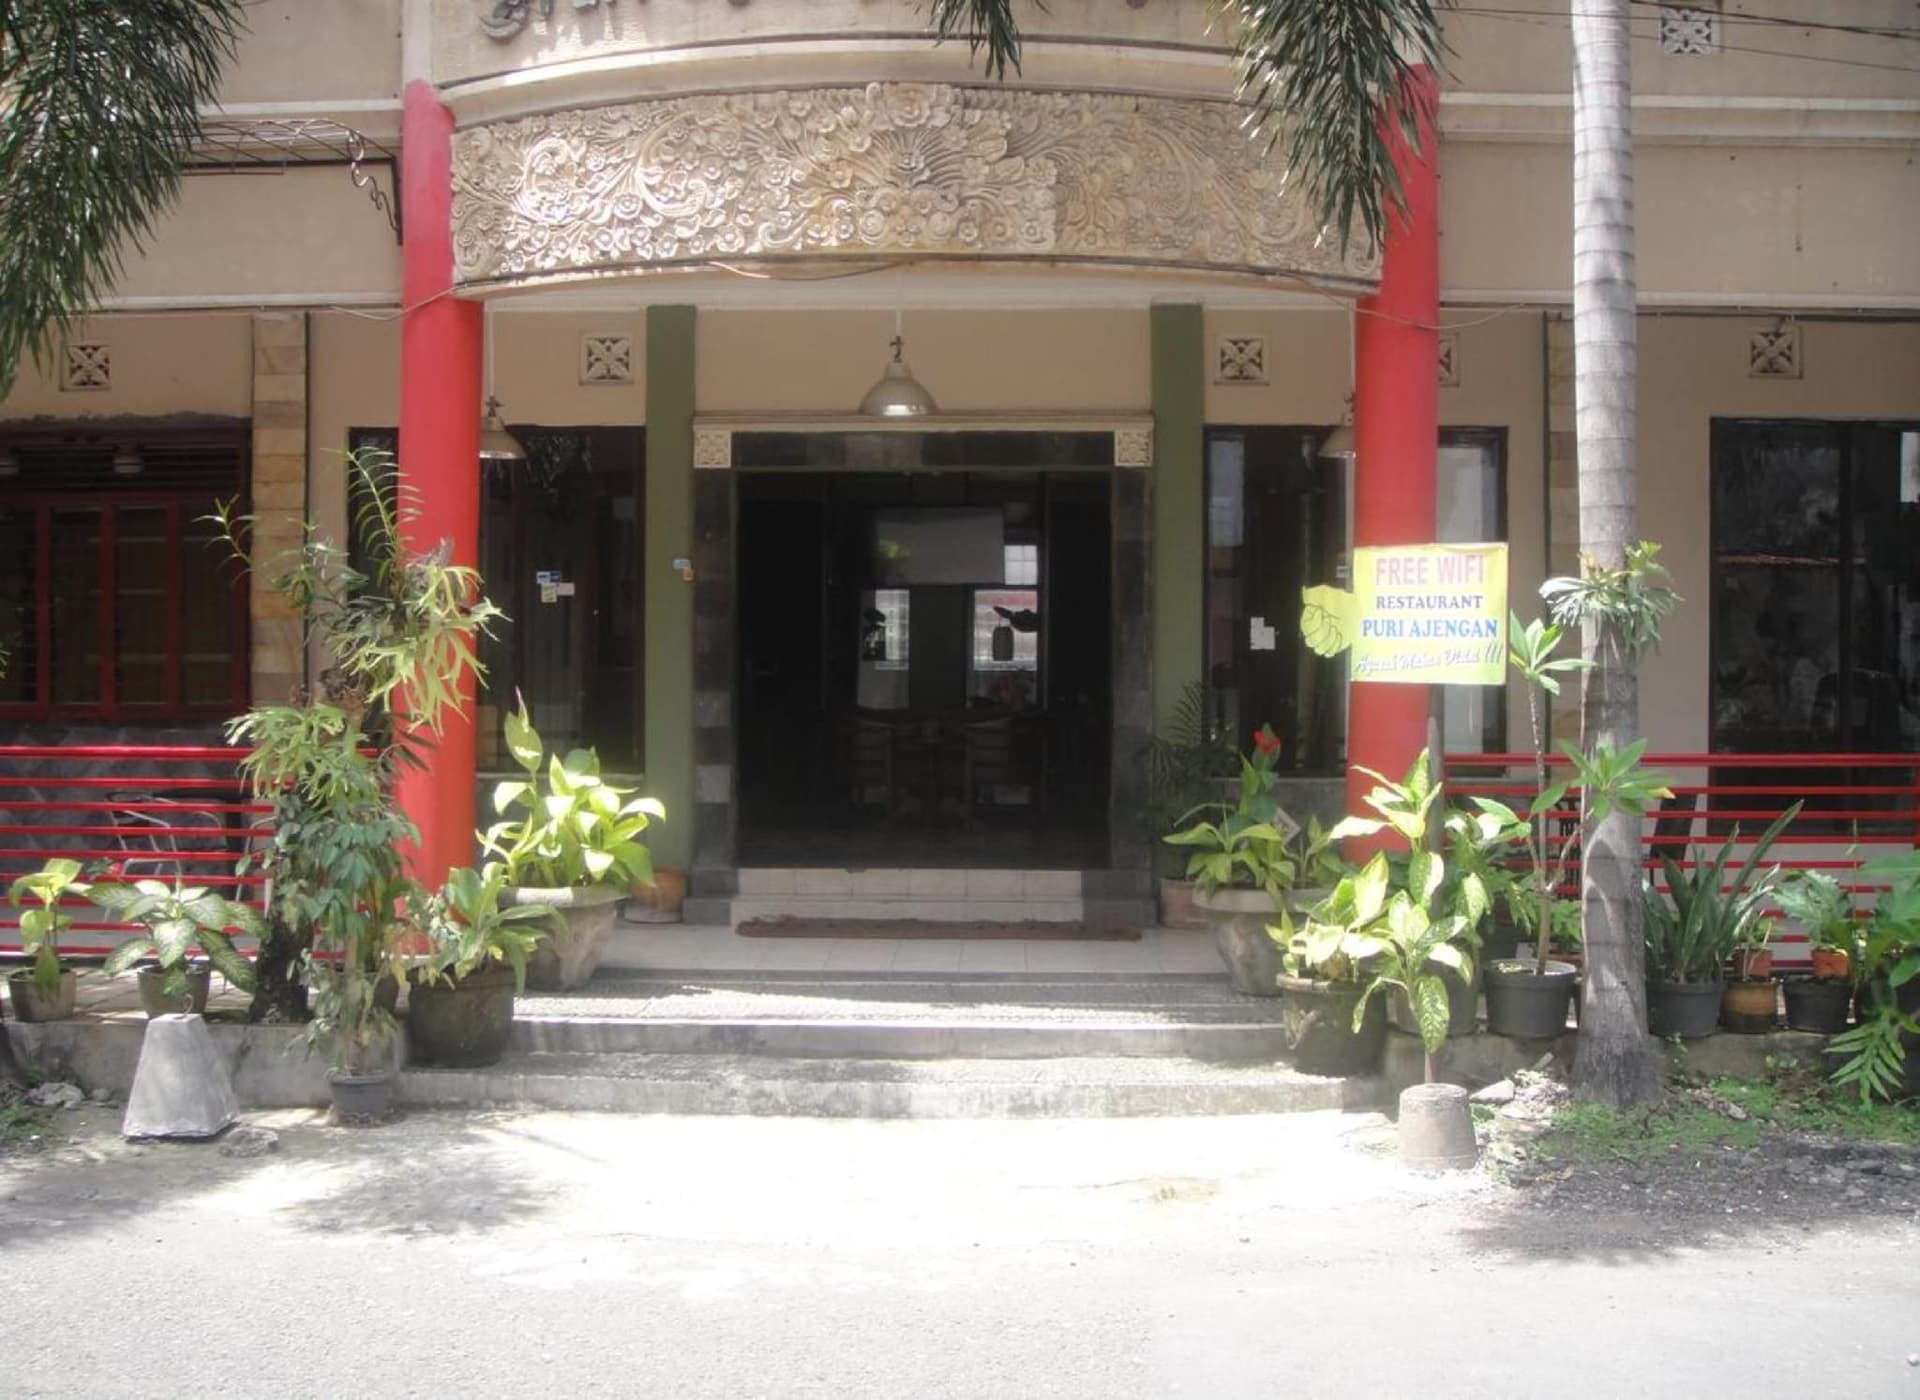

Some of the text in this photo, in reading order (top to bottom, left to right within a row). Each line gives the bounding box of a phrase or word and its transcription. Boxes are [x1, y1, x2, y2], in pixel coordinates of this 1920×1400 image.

[1375, 554, 1484, 585] FREE WIFI
[1375, 595, 1484, 609] RESTAURANT
[1362, 618, 1498, 638] PURI AJENGAN
